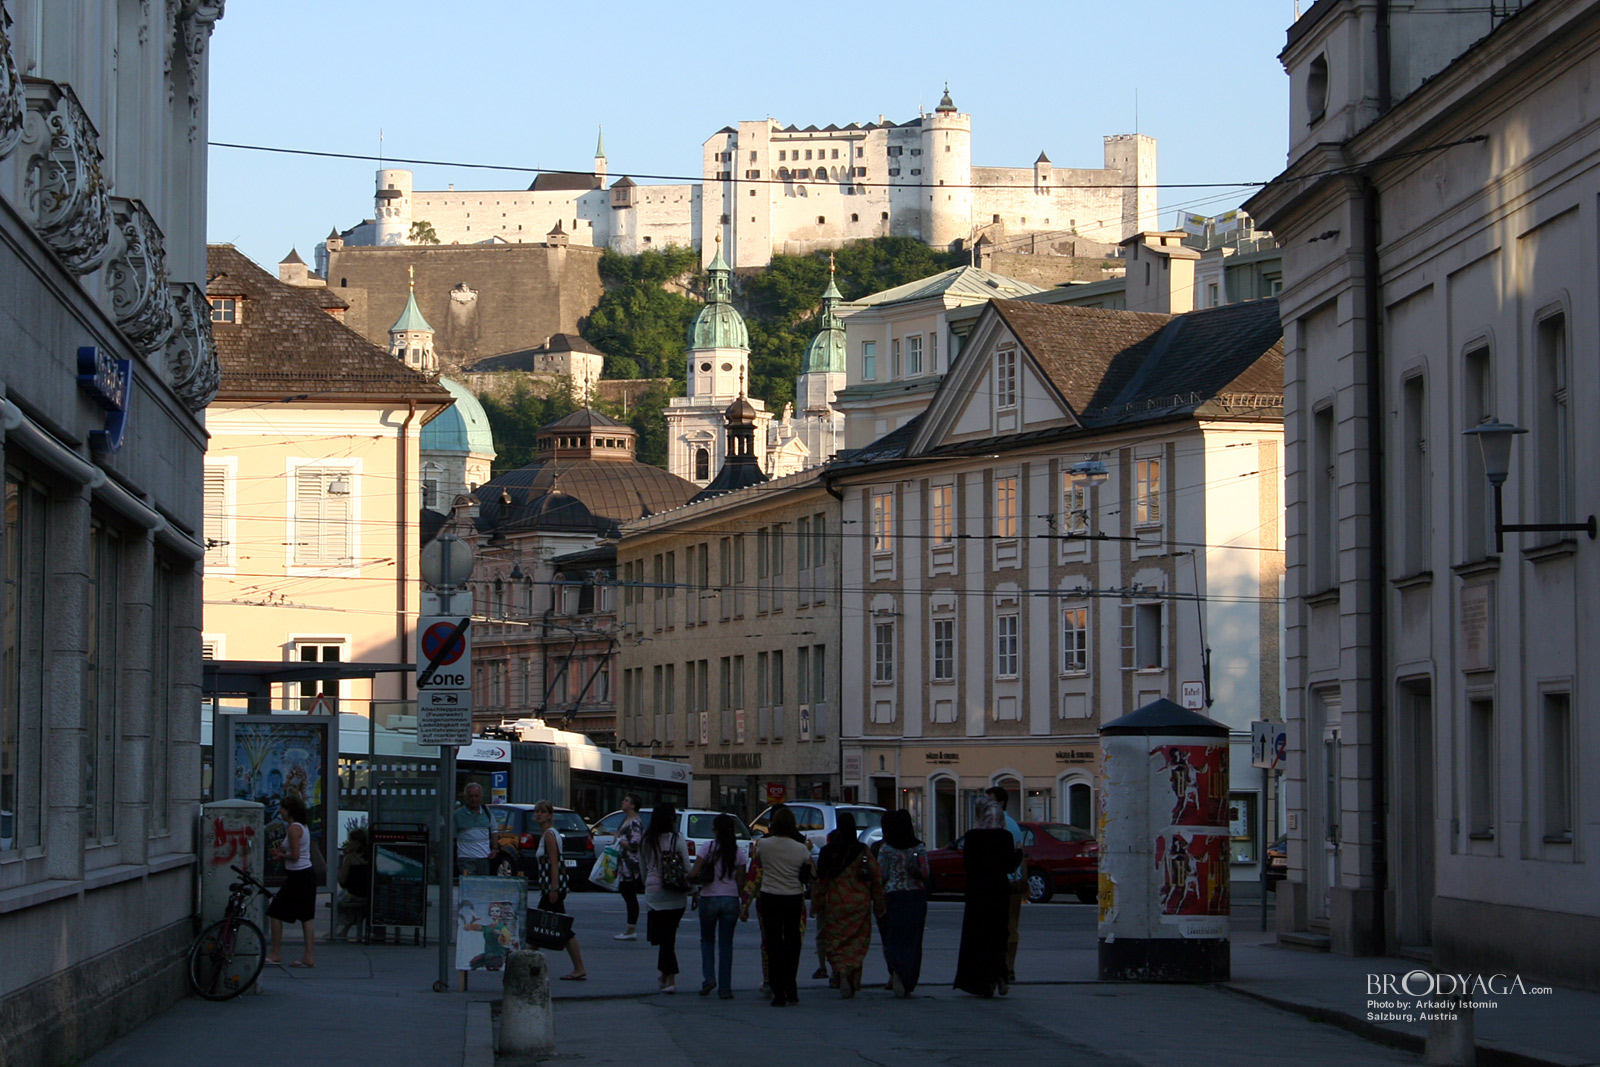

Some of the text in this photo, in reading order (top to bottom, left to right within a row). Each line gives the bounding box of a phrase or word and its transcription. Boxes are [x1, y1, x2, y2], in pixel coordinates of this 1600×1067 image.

[422, 670, 465, 686] Zone
[494, 774, 504, 787] P
[534, 926, 561, 936] MANGO
